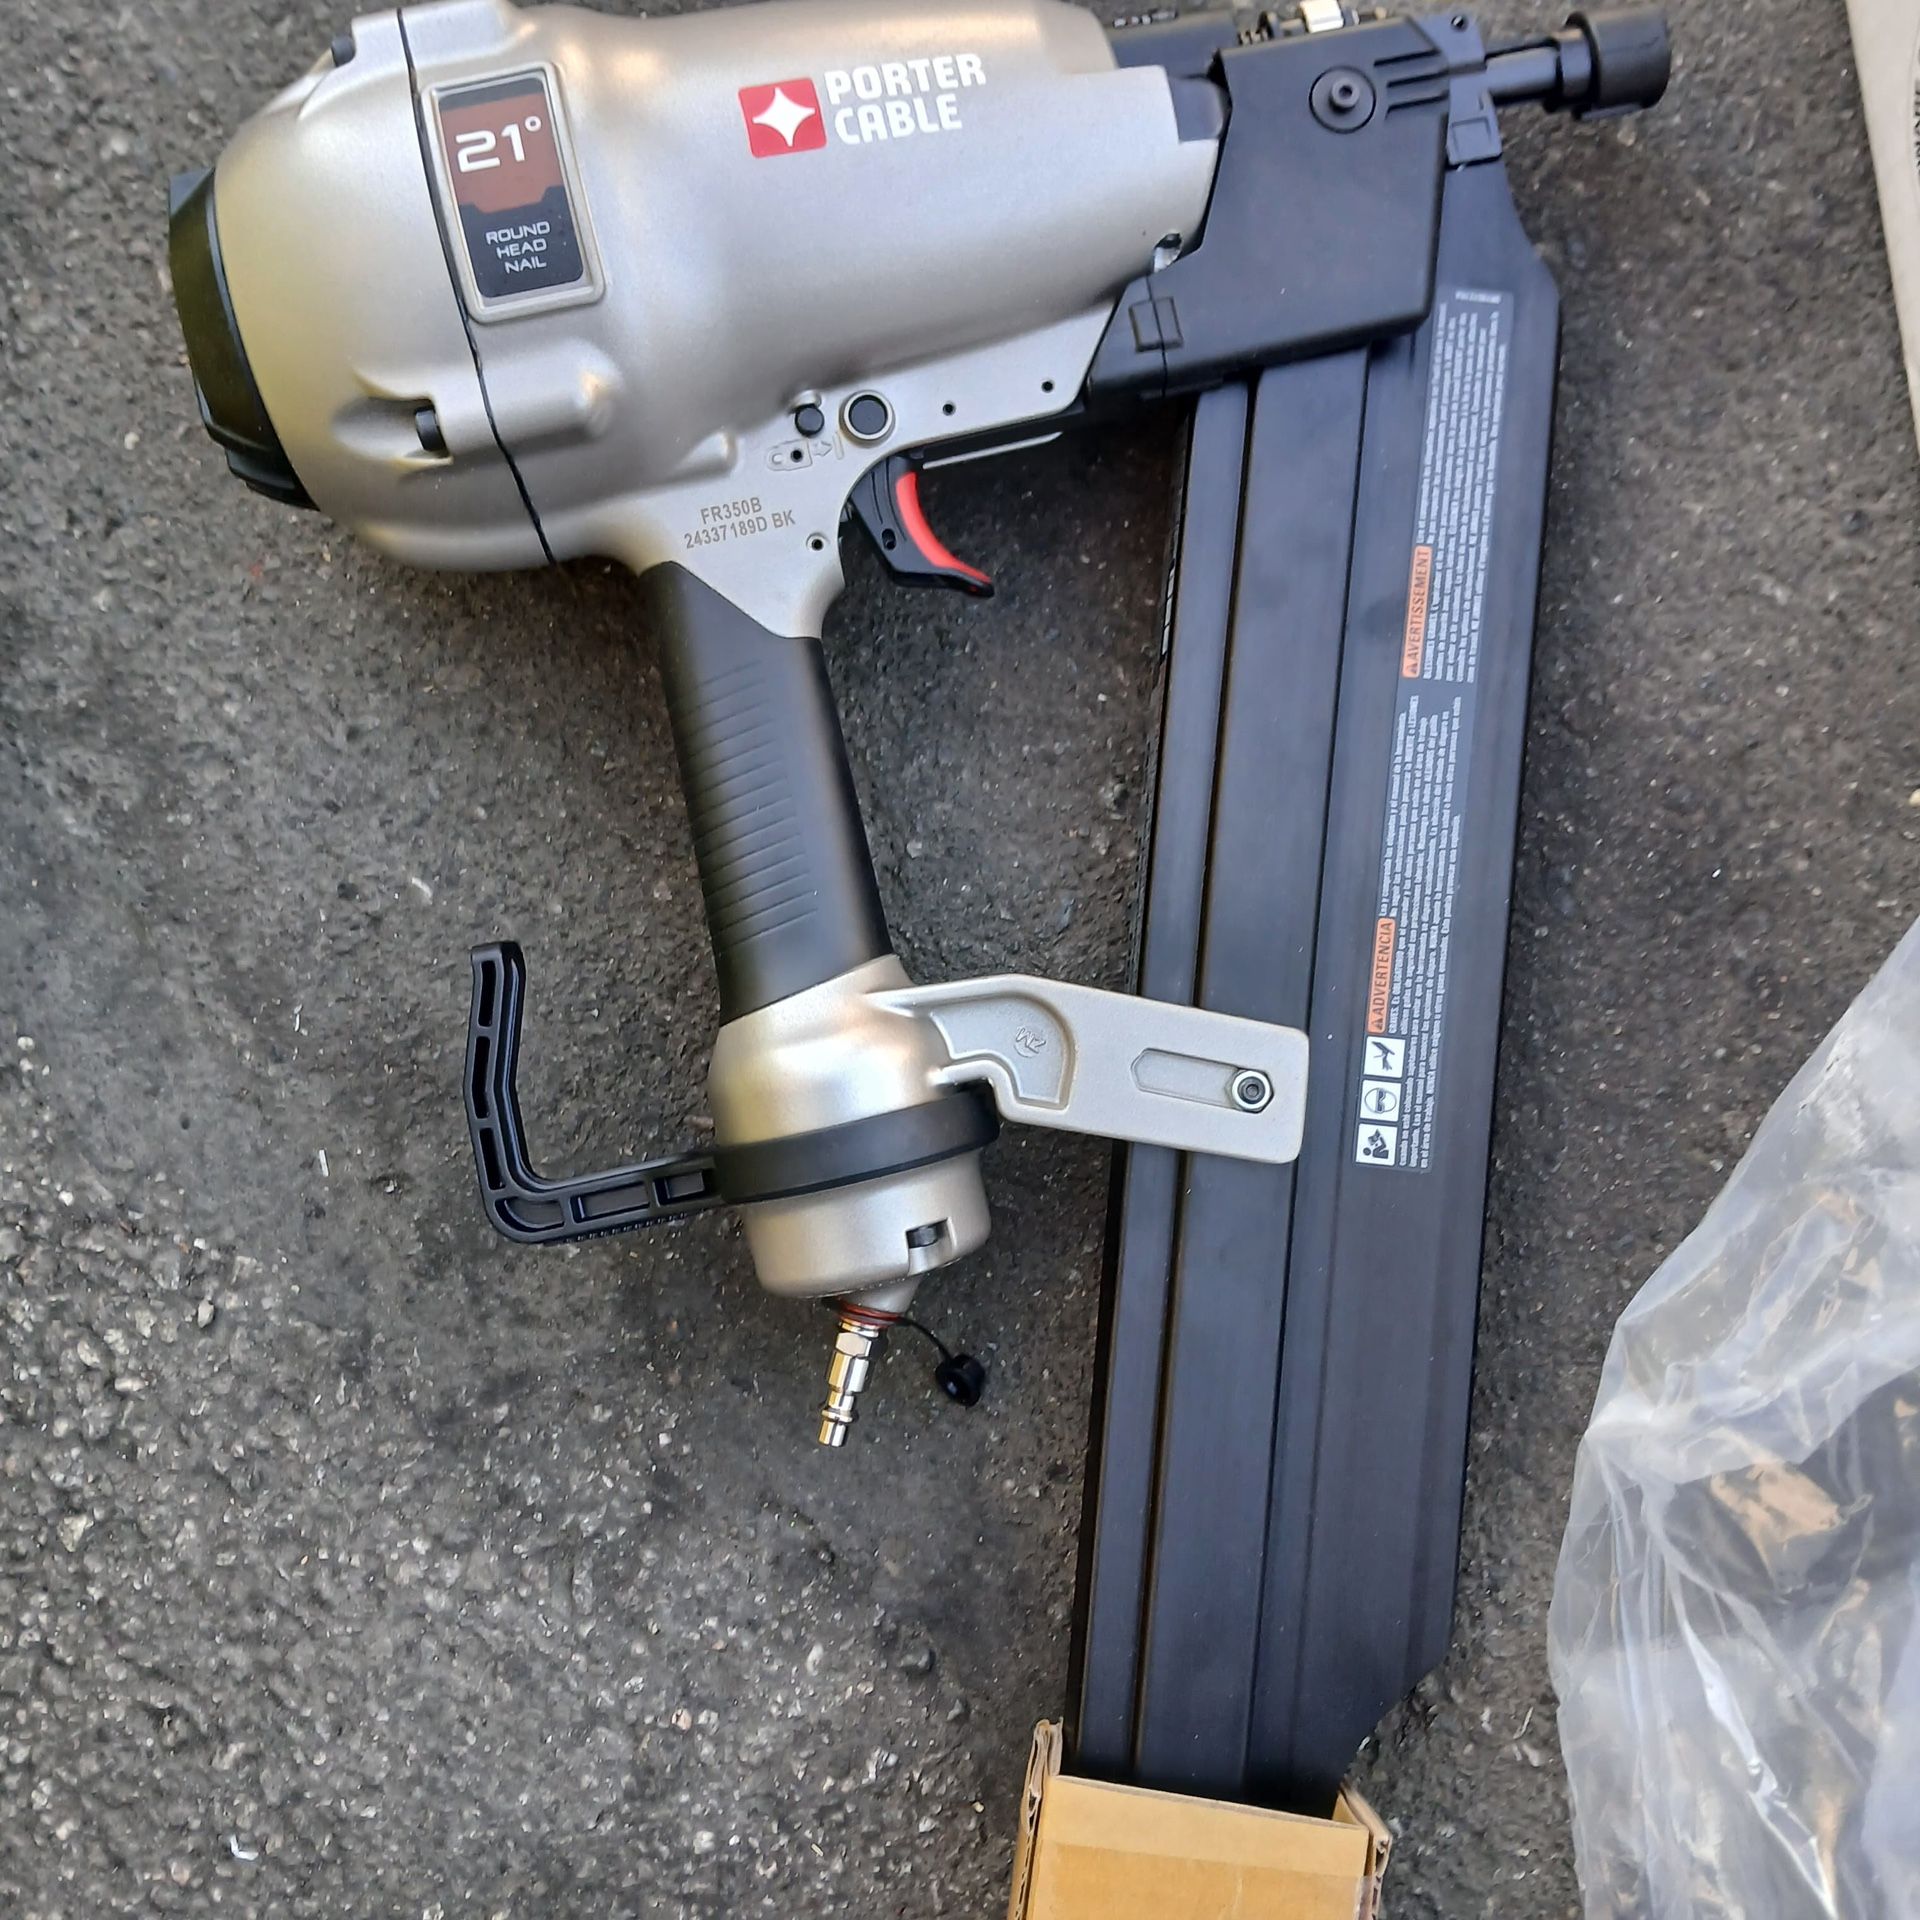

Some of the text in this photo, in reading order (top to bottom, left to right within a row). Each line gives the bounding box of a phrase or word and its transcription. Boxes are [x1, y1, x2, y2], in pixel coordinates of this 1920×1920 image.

[824, 53, 986, 105] PORTER
[834, 93, 963, 145] CABLE
[455, 116, 542, 173] 21°
[486, 221, 550, 245] ROUND
[496, 238, 547, 259] HEAD
[504, 256, 547, 274] NAIL
[684, 509, 796, 549] 24337189D BK
[700, 497, 762, 525] FR350B
[1406, 550, 1429, 660] AVERTISSEMENT
[1372, 922, 1393, 1017] ADVERTENCIA
